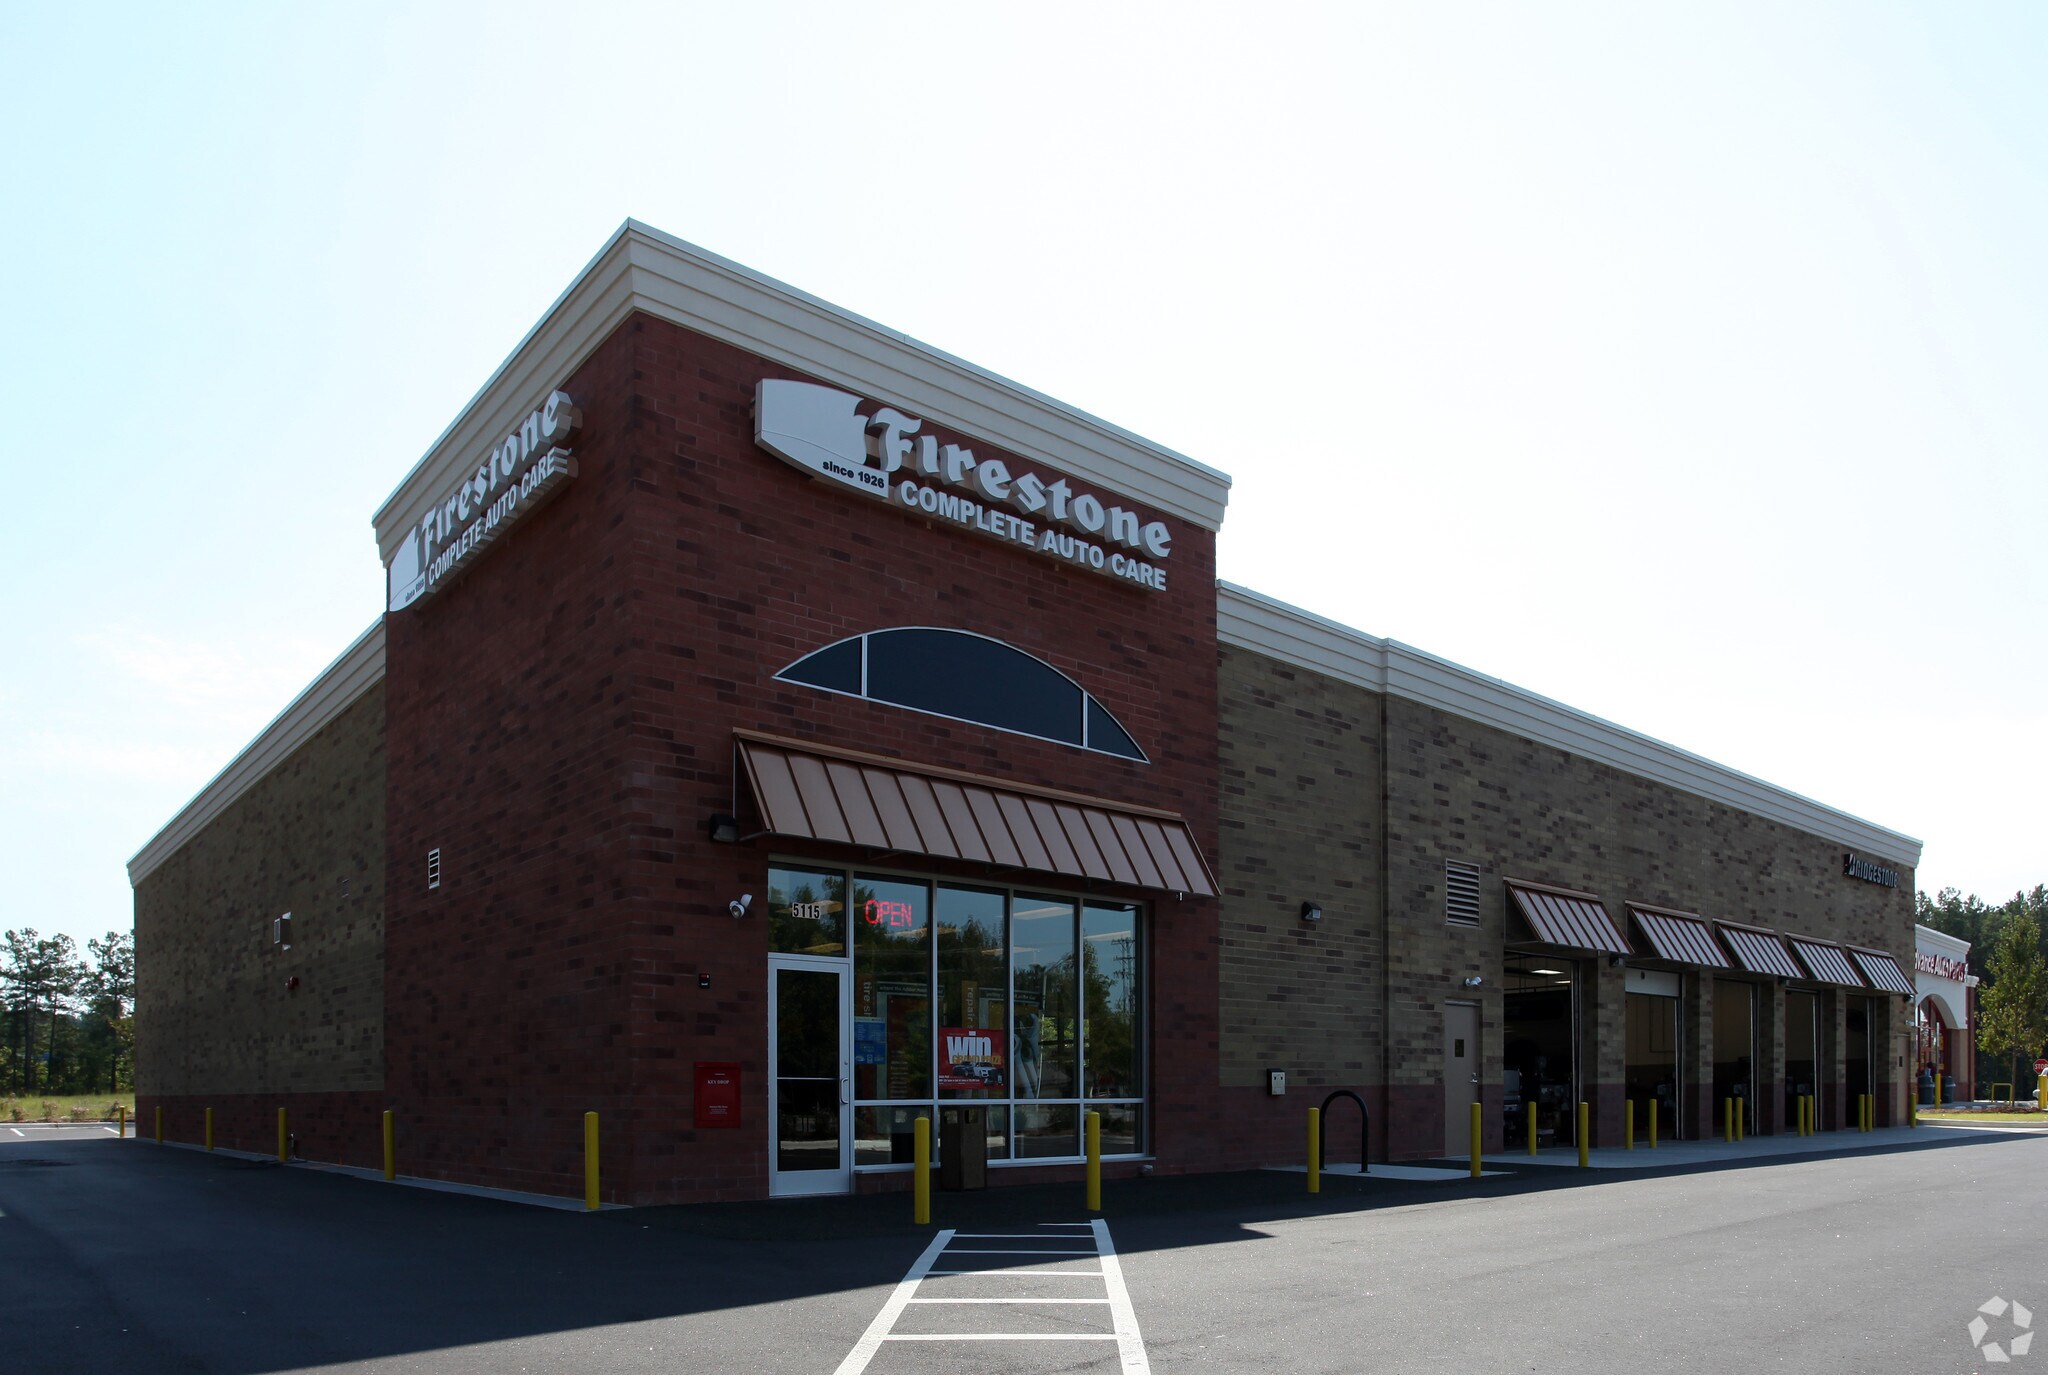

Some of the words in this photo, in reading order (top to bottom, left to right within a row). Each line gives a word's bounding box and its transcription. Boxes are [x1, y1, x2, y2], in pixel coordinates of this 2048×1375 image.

[422, 389, 565, 567] Firestone
[821, 460, 855, 480] since
[857, 471, 885, 489] 1926
[867, 407, 1172, 559] Firestone
[428, 517, 484, 586] COMPLETE
[485, 484, 519, 534] AUTO
[521, 446, 560, 496] CARE
[898, 480, 1035, 547] COMPLETE
[1042, 529, 1106, 569] AUTO
[1109, 554, 1168, 592] CARE
[793, 903, 820, 919] 5115
[865, 899, 912, 927] OPEN
[965, 987, 975, 1022] repair
[946, 1031, 992, 1065] win
